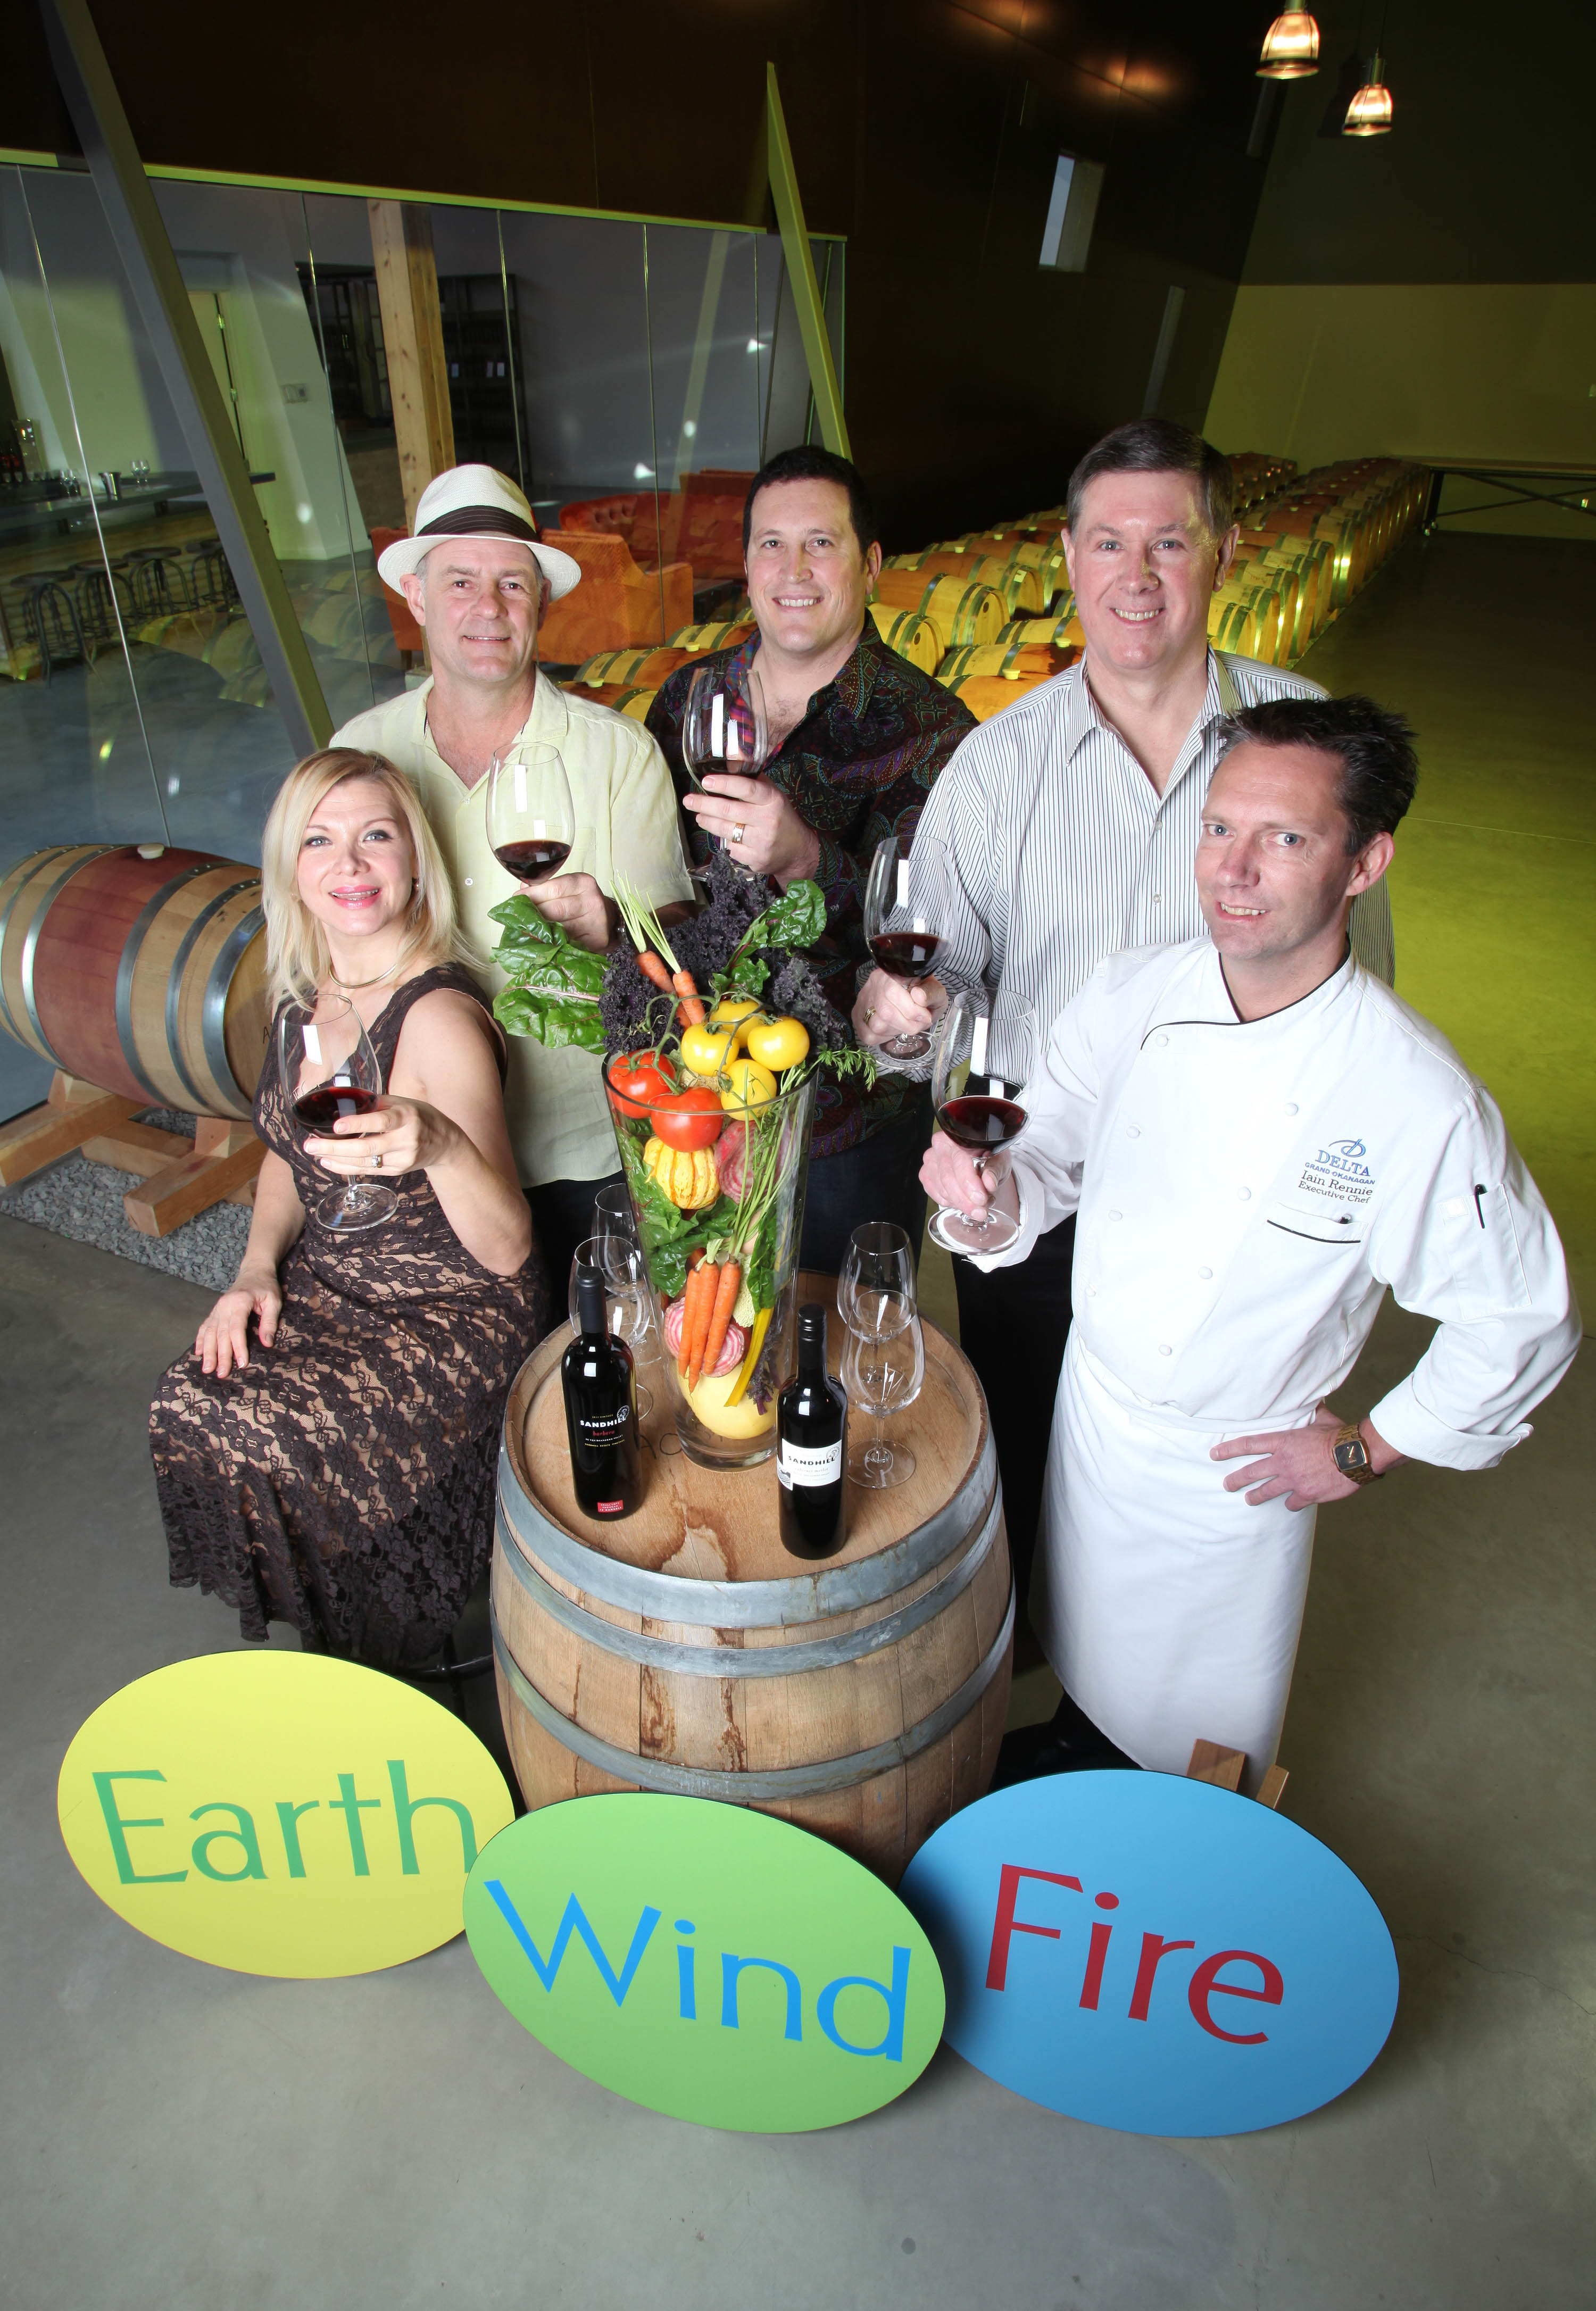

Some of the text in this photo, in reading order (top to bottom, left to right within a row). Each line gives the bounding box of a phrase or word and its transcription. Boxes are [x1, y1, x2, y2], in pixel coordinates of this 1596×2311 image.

[1304, 1162, 1376, 1185] GRAND OKANAGAN
[1315, 1149, 1371, 1177] DELTA
[1298, 1180, 1371, 1203] Executive Chef
[1301, 1169, 1373, 1195] Iain Rennie
[580, 1416, 626, 1428] SANDHILL
[788, 1456, 835, 1466] SANDHILL
[92, 1759, 479, 1885] Earth
[986, 1863, 1284, 2045] Fire
[484, 1880, 911, 2063] Wind
